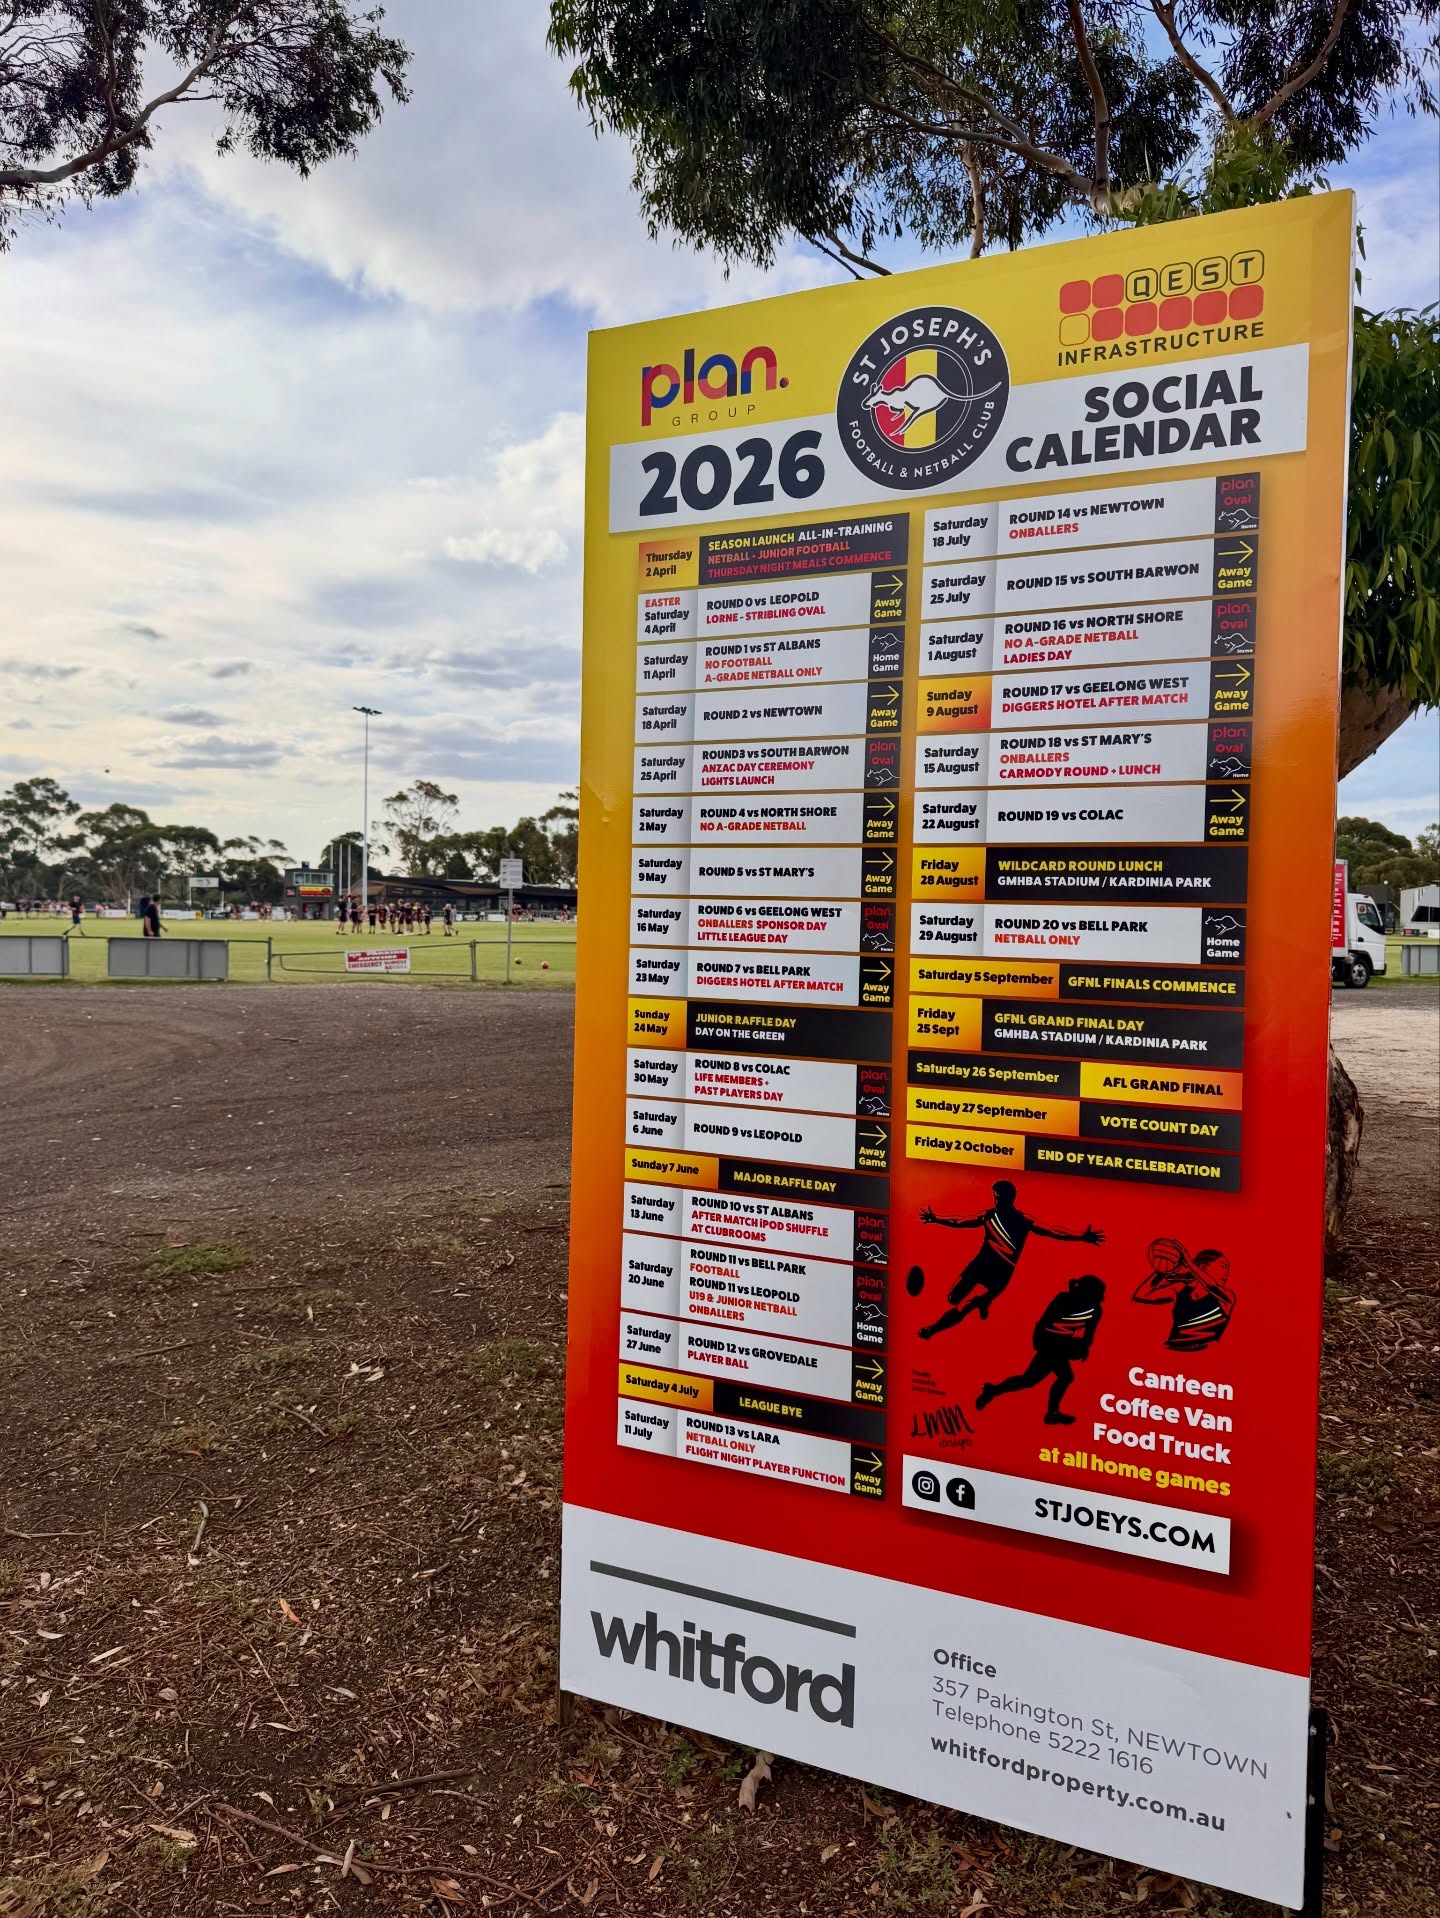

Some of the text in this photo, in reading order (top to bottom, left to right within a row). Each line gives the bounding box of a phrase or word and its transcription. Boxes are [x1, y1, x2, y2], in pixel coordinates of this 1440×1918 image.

[1133, 256, 1256, 297] QEST
[853, 318, 991, 386] ST JOSEPH'S
[1058, 322, 1264, 366] INFRASTRUCTURE
[1084, 365, 1263, 423] SOCIAL
[672, 404, 755, 426] GROUP
[849, 401, 994, 477] FOOTBALL & NETBALL CLUB
[1005, 408, 1261, 472] CALENDAR
[639, 430, 825, 516] 2026
[708, 522, 893, 551] SEASON LAUNCH ALL-IN-TRAINING
[1009, 523, 1079, 540] ONBALLERS
[646, 551, 692, 563] Thursday
[708, 552, 891, 578] THURSDAY NIGHT MEALS COMMENCE
[646, 566, 676, 577] 2 April
[931, 574, 986, 588] Saturday
[1007, 563, 1199, 591] ROUND 15 vs SOUTH BARWON
[707, 599, 743, 610] ROUND
[754, 597, 766, 606] vs
[770, 592, 819, 605] LEOPOLD
[930, 592, 971, 605] 25 July
[1004, 630, 1139, 649] NO A-GRADE NETBALL
[1004, 650, 1072, 664] LADIES DAY
[927, 689, 972, 702] Sunday
[1002, 693, 1188, 713] DIGGERS HOTEL AFTER MATCH
[927, 704, 979, 717] 9 August
[1000, 733, 1152, 750] ROUND 18 vs ST MARY'S
[702, 761, 815, 772] ANZAC DAY CEREMONY
[702, 776, 775, 786] LIGHTS LAUNCH
[998, 860, 1162, 872] WILDCARD ROUND LUNCH
[998, 875, 1212, 889] GMHBA STADIUM / KARDINIA PARK
[698, 906, 842, 917] ROUND 6 vs GEELONG WEST
[697, 932, 788, 943] LITTLE LEAGUE DAY
[918, 969, 1054, 986] Saturday 5 September
[1068, 976, 1236, 994] GFNL FINALS COMMENCE
[634, 1009, 670, 1021] Sunday
[696, 1014, 797, 1028] JUNIOR RAFFLE DAY
[634, 1023, 668, 1036] 24 May
[695, 1027, 785, 1041] DAY ON THE GREEN
[916, 1062, 1060, 1084] Saturday 26 September
[1103, 1076, 1223, 1096] AFL GRAND FINAL
[694, 1123, 802, 1143] ROUND 9 vs LEOPOLD
[1101, 1116, 1219, 1137] VOTE COUNT DAY
[914, 1136, 1014, 1157] Friday 2 October
[632, 1158, 699, 1175] Sunday 7 June
[1038, 1149, 1221, 1178] END OF YEAR CELEBRATION
[733, 1171, 836, 1192] MAJOR RAFFLE DAY
[625, 1374, 700, 1399] Saturday 4 July
[1129, 1367, 1234, 1401] Canteen
[739, 1397, 803, 1418] LEAGUE BYE
[1100, 1393, 1233, 1432] Coffee Van
[1093, 1423, 1231, 1465] Food Truck
[686, 1445, 845, 1486] FLIGHT NIGHT PLAYER FUNCTION
[1039, 1448, 1231, 1497] at all home games
[1035, 1497, 1215, 1554] STJOEYS.COM
[590, 1608, 856, 1729] whitford
[933, 1649, 996, 1678] Office
[932, 1676, 1268, 1780] 357 Pakington St, NEWTOWN
[932, 1699, 1153, 1774] Telephone 5222 1616
[931, 1736, 1225, 1831] whitfordproperty.com.au
